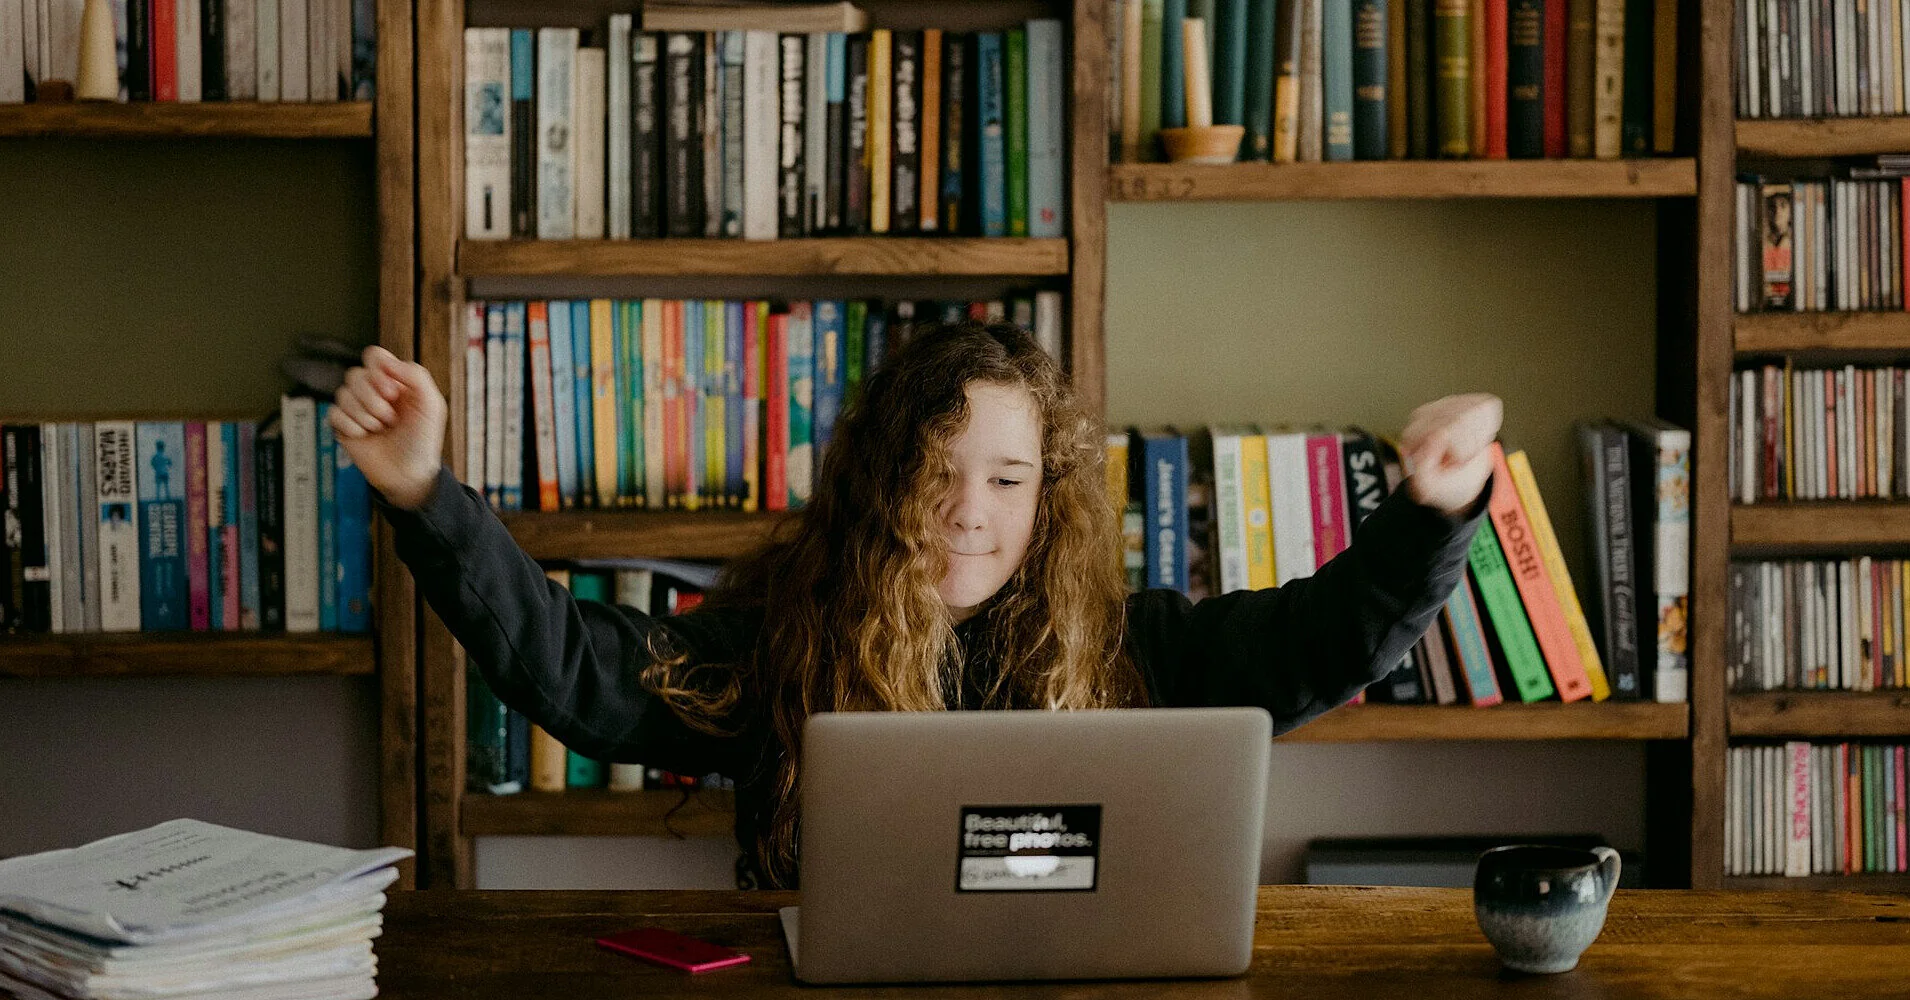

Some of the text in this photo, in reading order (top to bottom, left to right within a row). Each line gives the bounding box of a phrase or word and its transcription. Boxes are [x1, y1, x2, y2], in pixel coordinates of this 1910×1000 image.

[100, 428, 118, 497] MARKS
[118, 428, 131, 495] HOWARD
[1349, 450, 1381, 523] SAV
[1502, 509, 1539, 581] BOSH!
[963, 832, 1093, 852] free photos.
[964, 812, 1068, 832] Beautiful,
